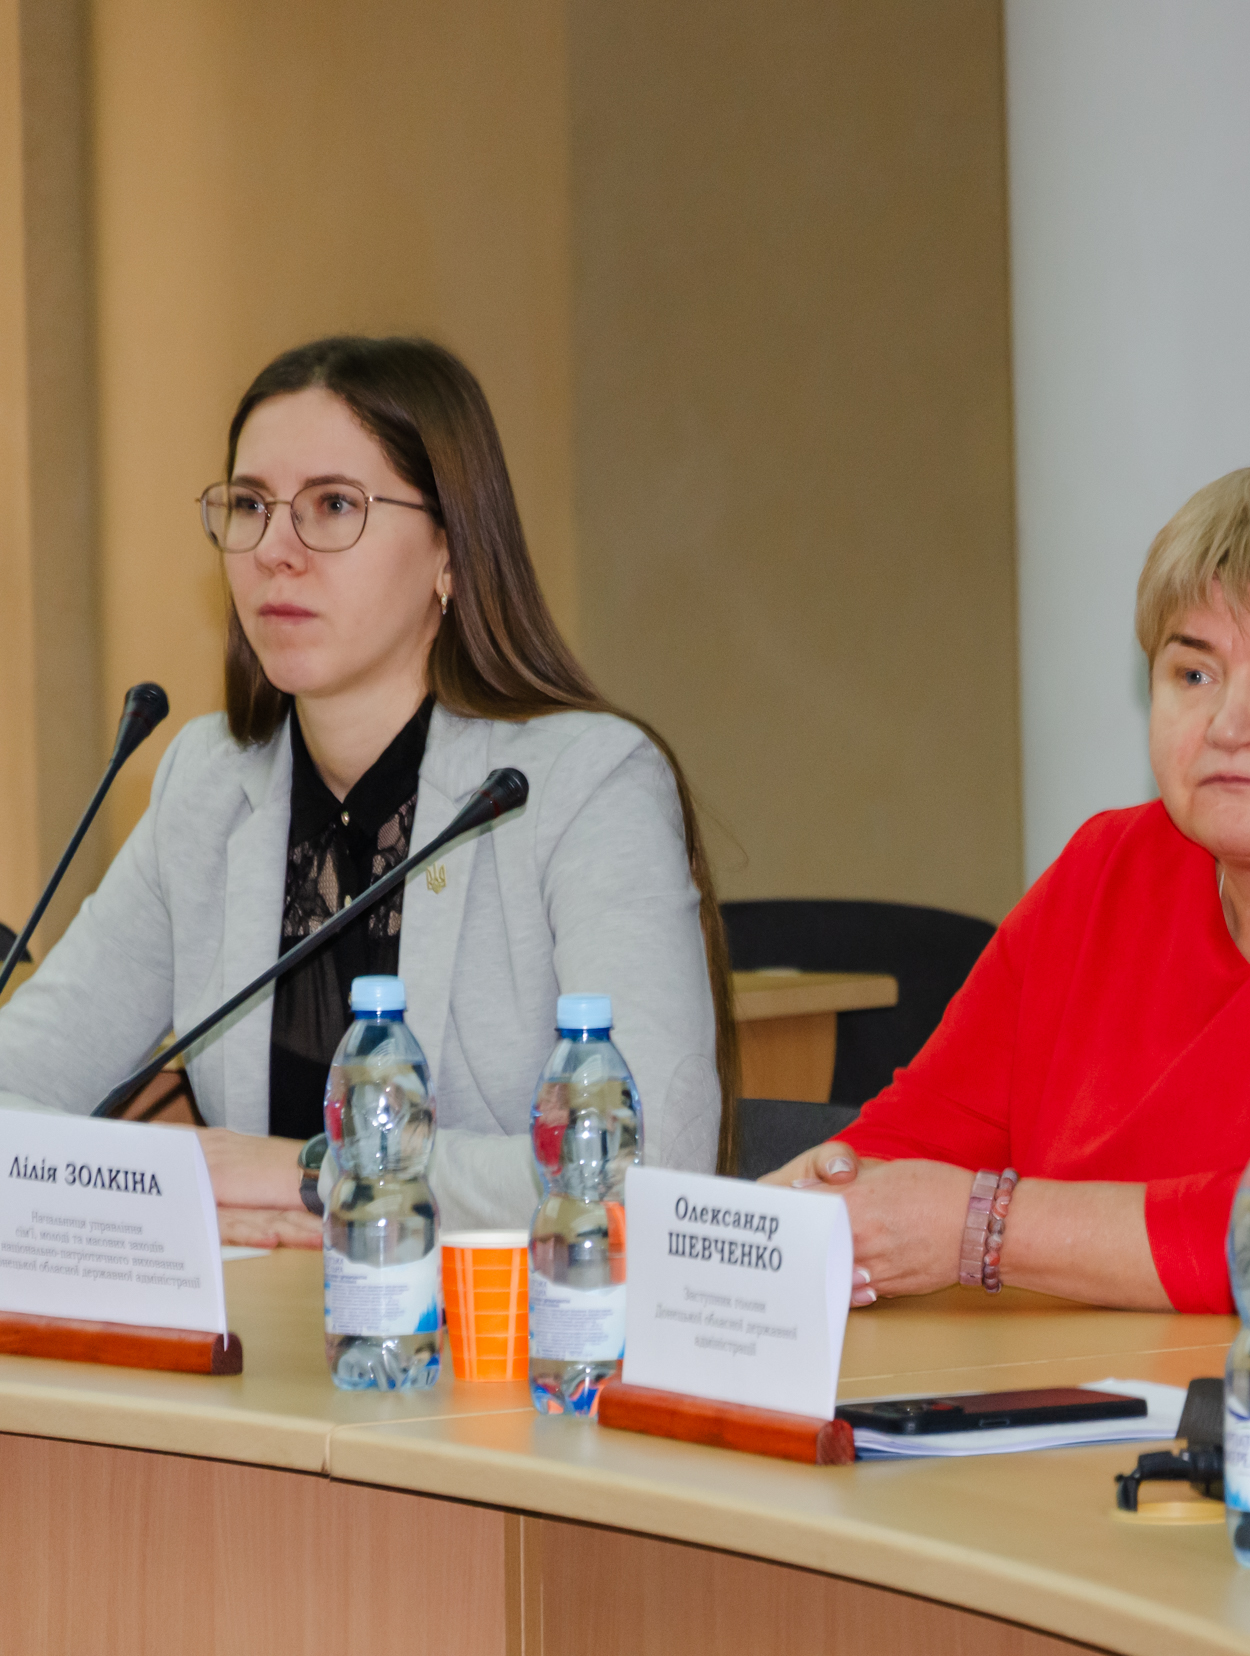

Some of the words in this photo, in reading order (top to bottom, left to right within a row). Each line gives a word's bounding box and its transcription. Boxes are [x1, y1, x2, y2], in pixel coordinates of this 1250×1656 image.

[8, 1155, 57, 1183] Лілія
[64, 1163, 162, 1197] ЗОЛКІНА
[88, 1220, 143, 1236] управління
[675, 1196, 779, 1242] Олександр
[668, 1231, 783, 1273] ШЕВЧЕНКО
